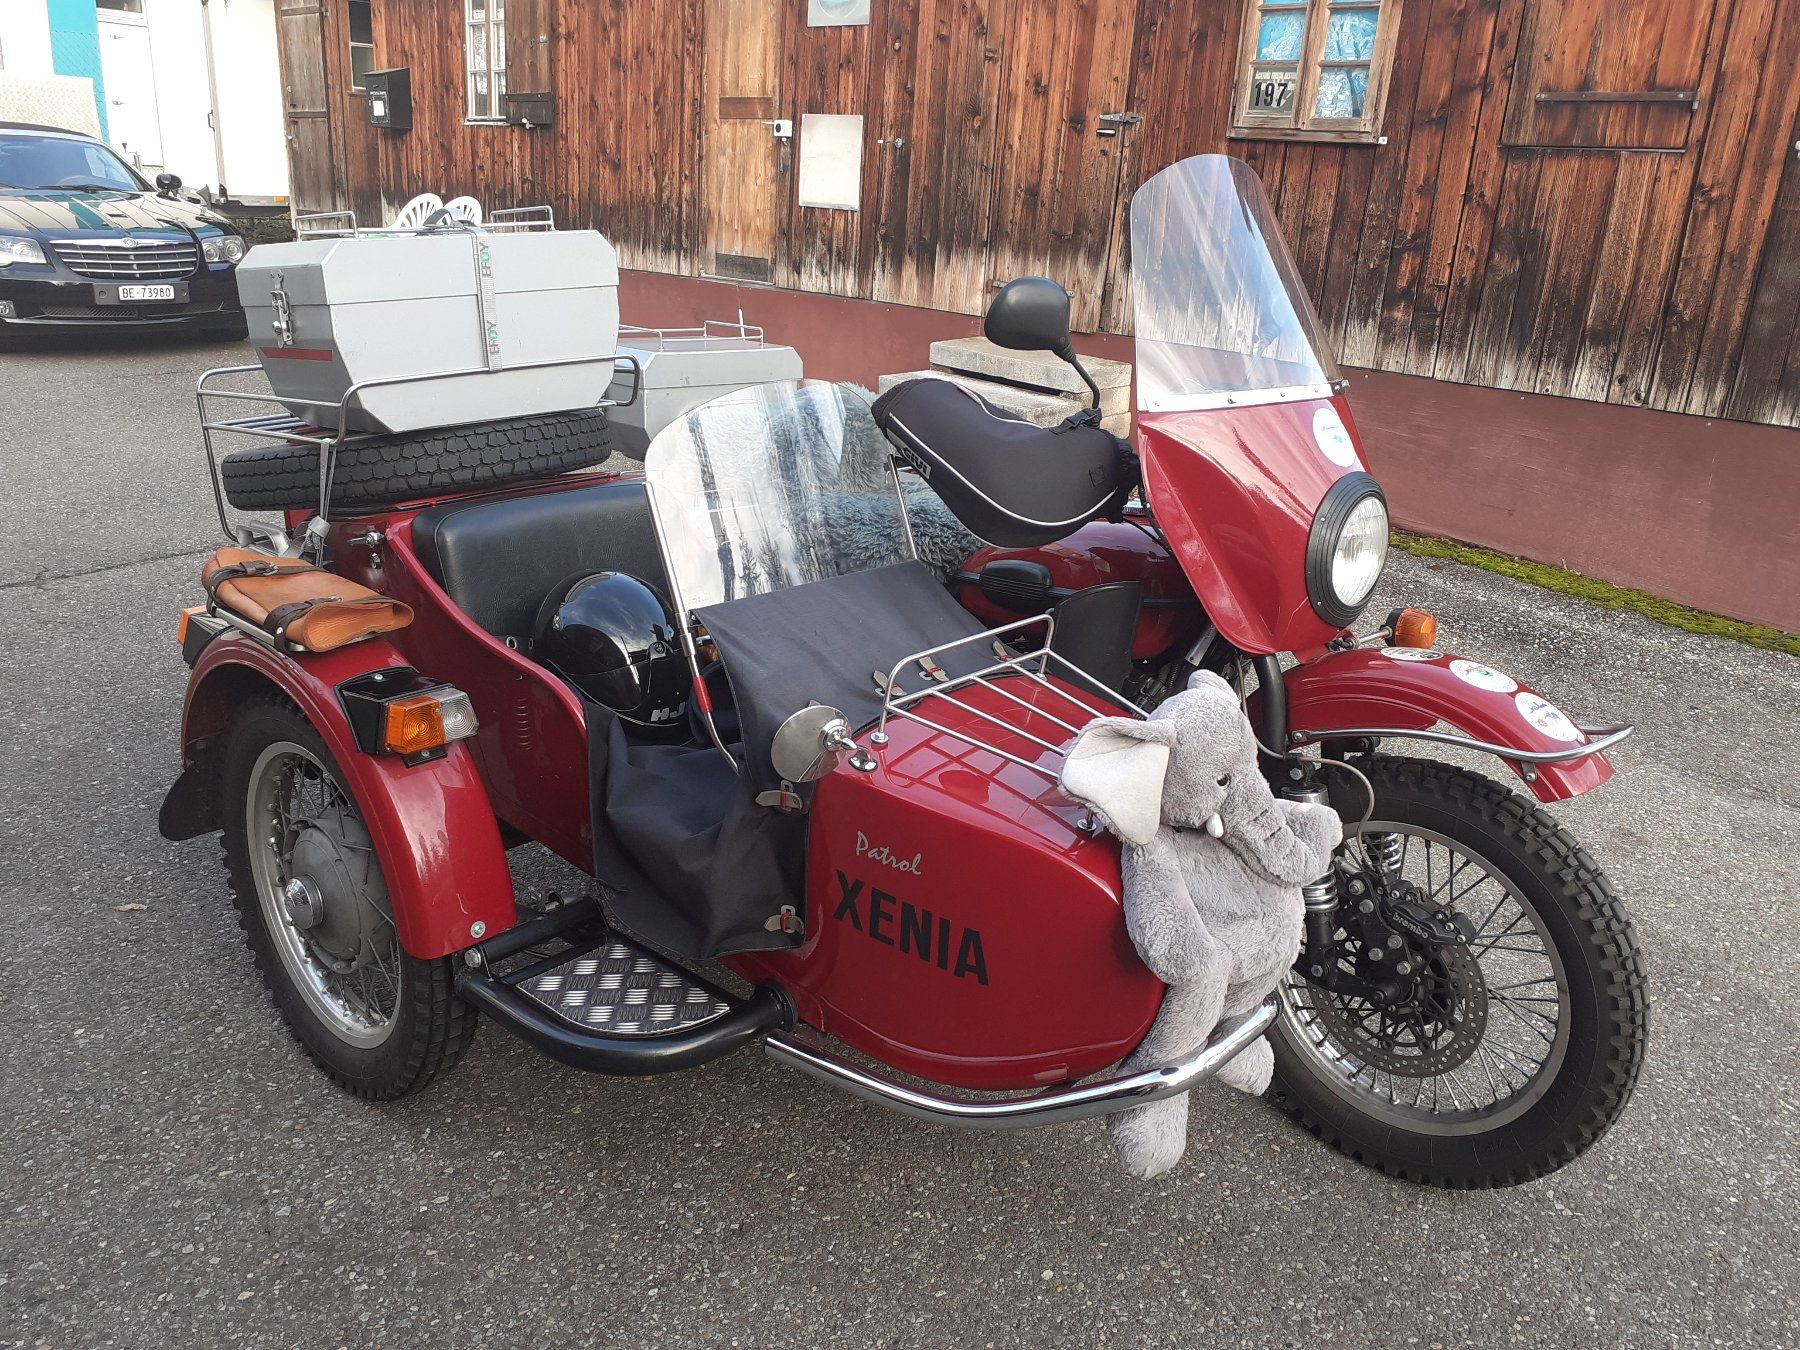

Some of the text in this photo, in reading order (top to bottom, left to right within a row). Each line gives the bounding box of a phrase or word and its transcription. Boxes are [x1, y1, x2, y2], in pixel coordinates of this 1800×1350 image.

[1254, 81, 1288, 107] 197
[855, 830, 922, 876] Patrol
[832, 868, 989, 986] XENIA
[1392, 911, 1429, 939] brembo
